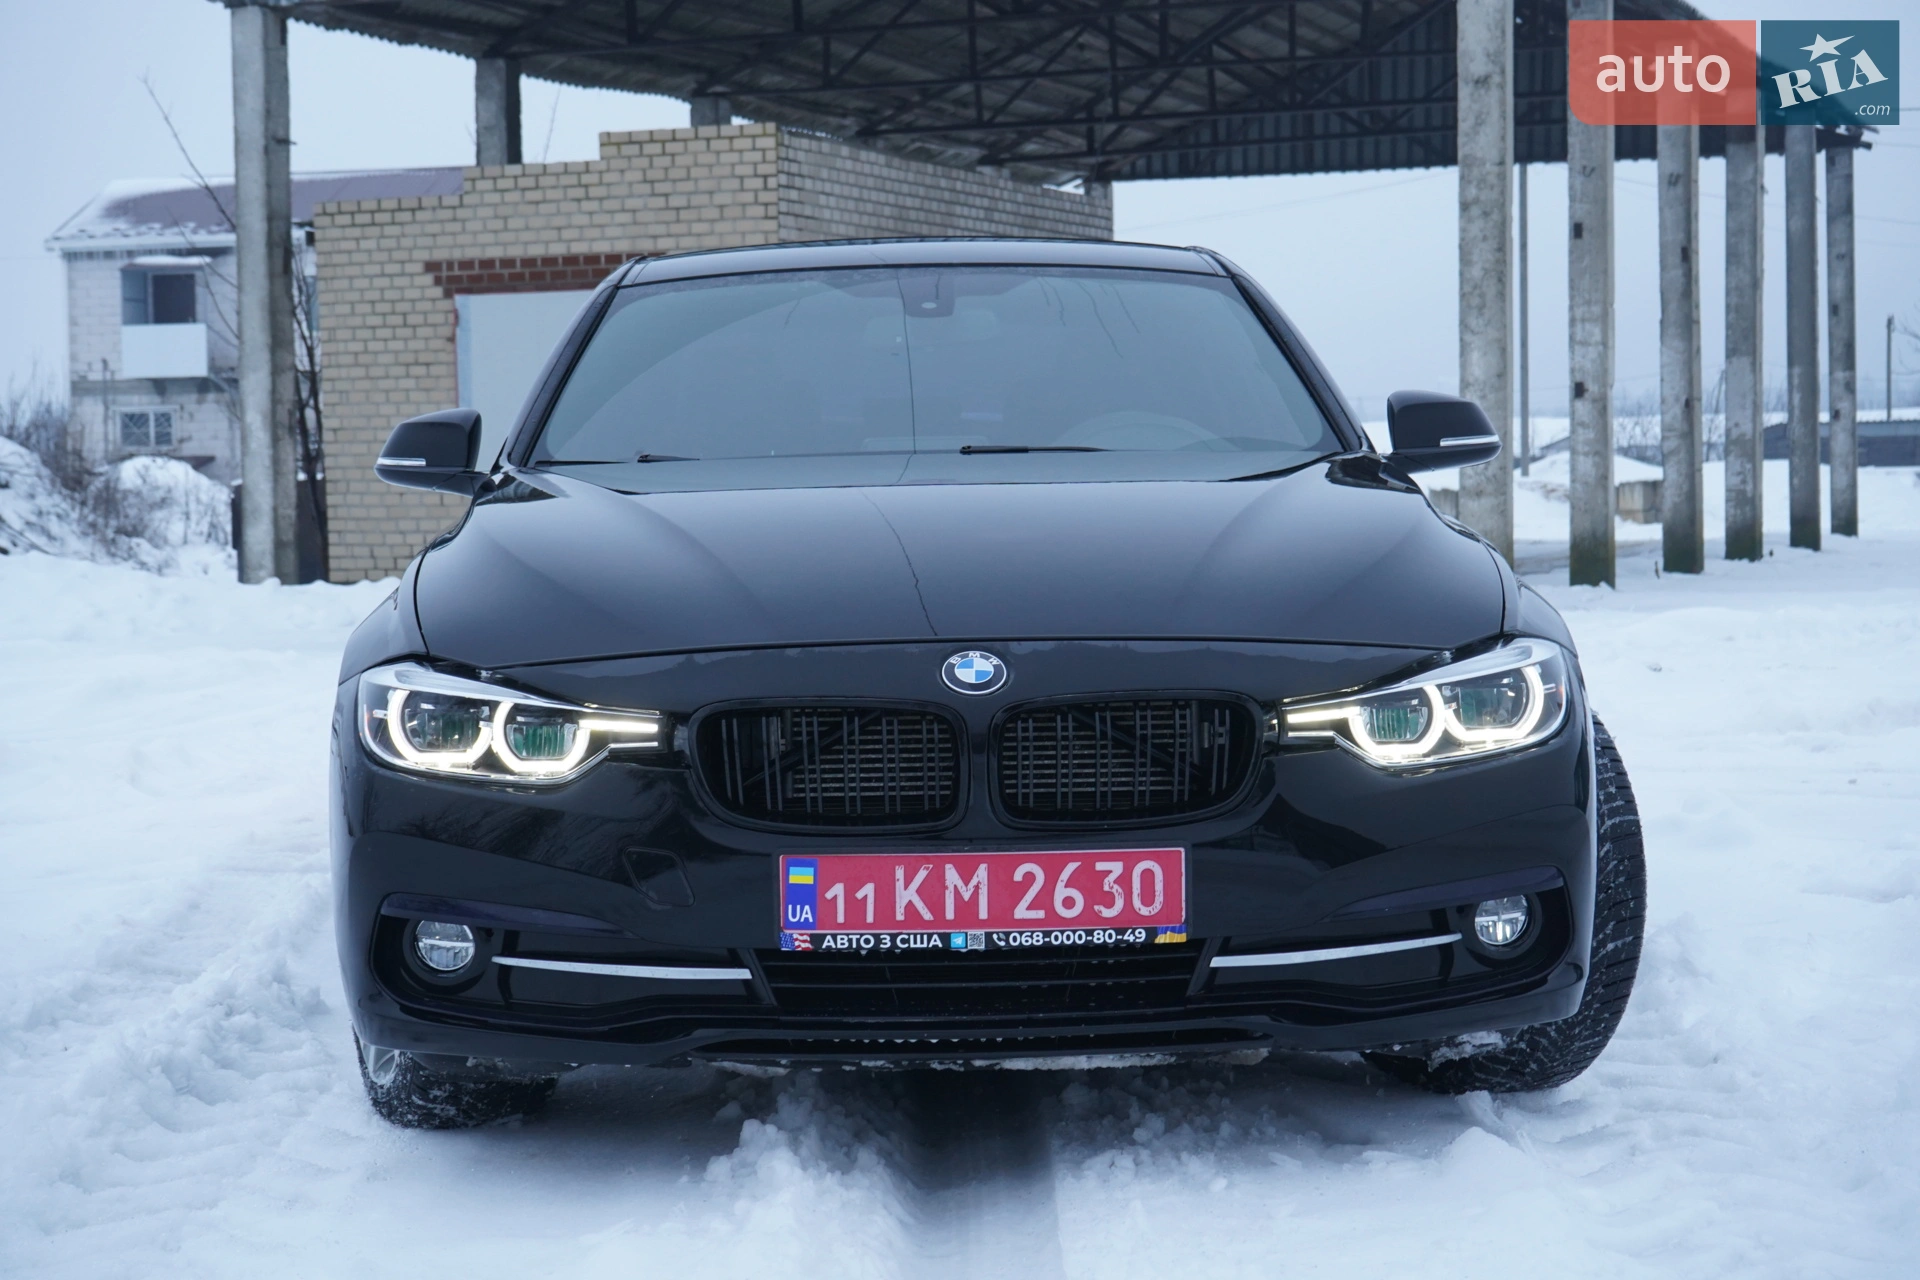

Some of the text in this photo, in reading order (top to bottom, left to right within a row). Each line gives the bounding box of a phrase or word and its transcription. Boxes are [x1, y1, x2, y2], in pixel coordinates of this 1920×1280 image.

[949, 652, 1001, 665] BMW
[824, 859, 1164, 924] 11 KM 2630
[787, 904, 814, 923] UA
[821, 934, 875, 949] АВТО
[896, 933, 943, 949] США
[1008, 928, 1147, 947] 068-000-80-49
